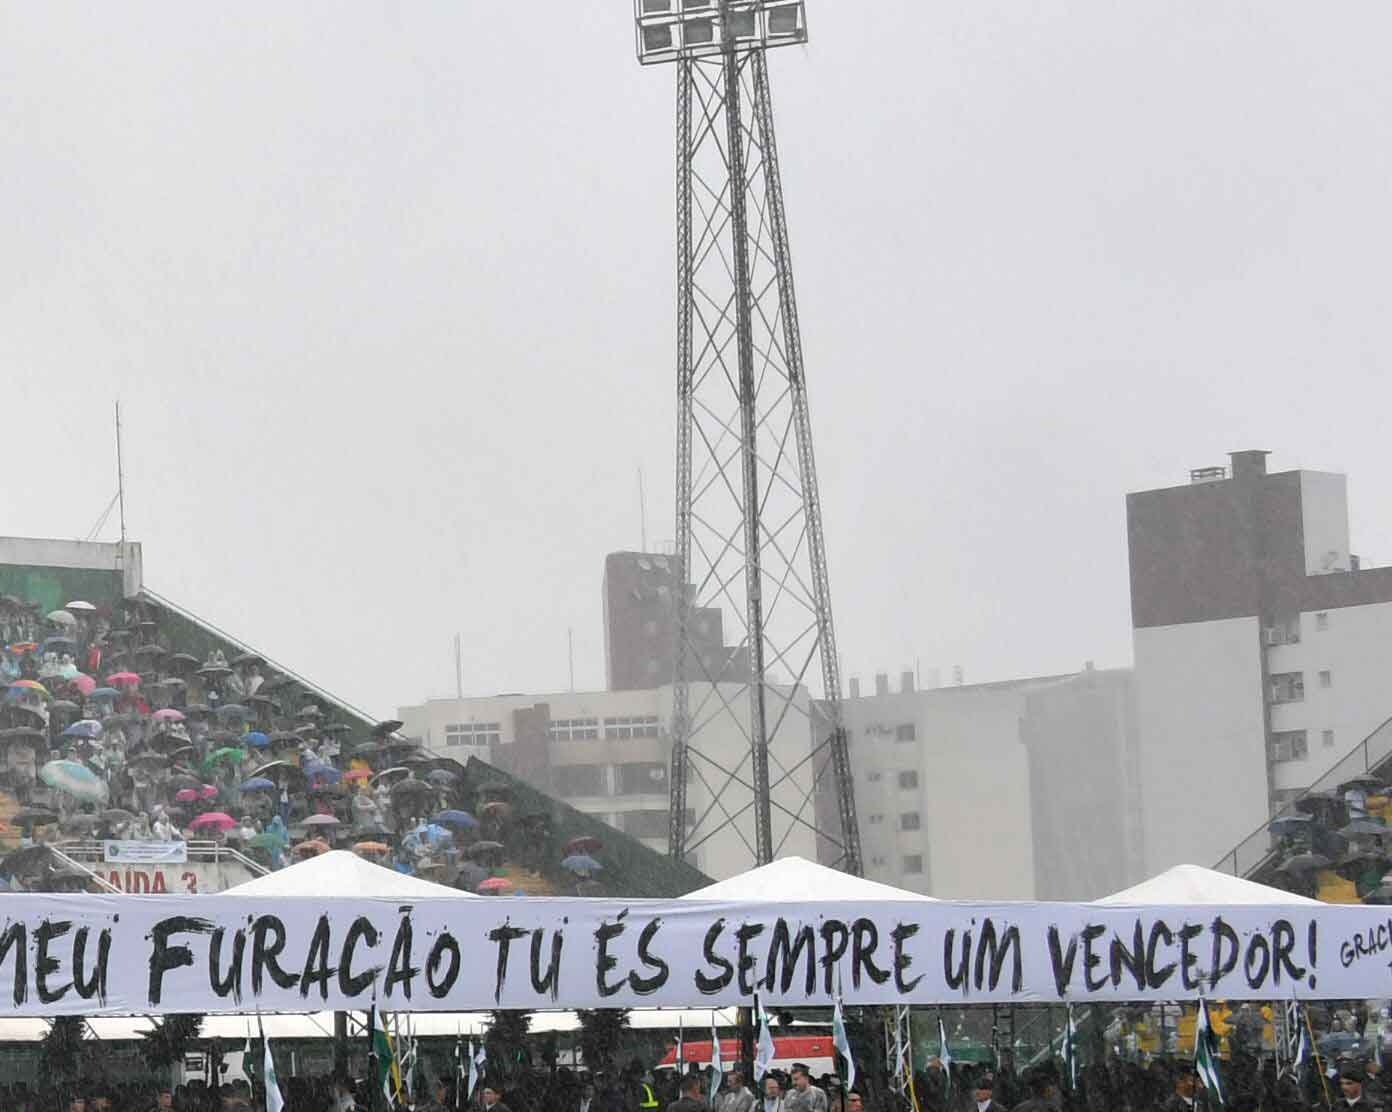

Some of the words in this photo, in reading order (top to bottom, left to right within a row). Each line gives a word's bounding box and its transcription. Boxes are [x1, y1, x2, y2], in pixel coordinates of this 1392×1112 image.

[489, 918, 564, 1003] TU
[594, 908, 669, 997] ÉS
[695, 914, 923, 996] SEMPRE
[944, 917, 1023, 994] UM
[1048, 916, 1317, 999] VENCEDOR!
